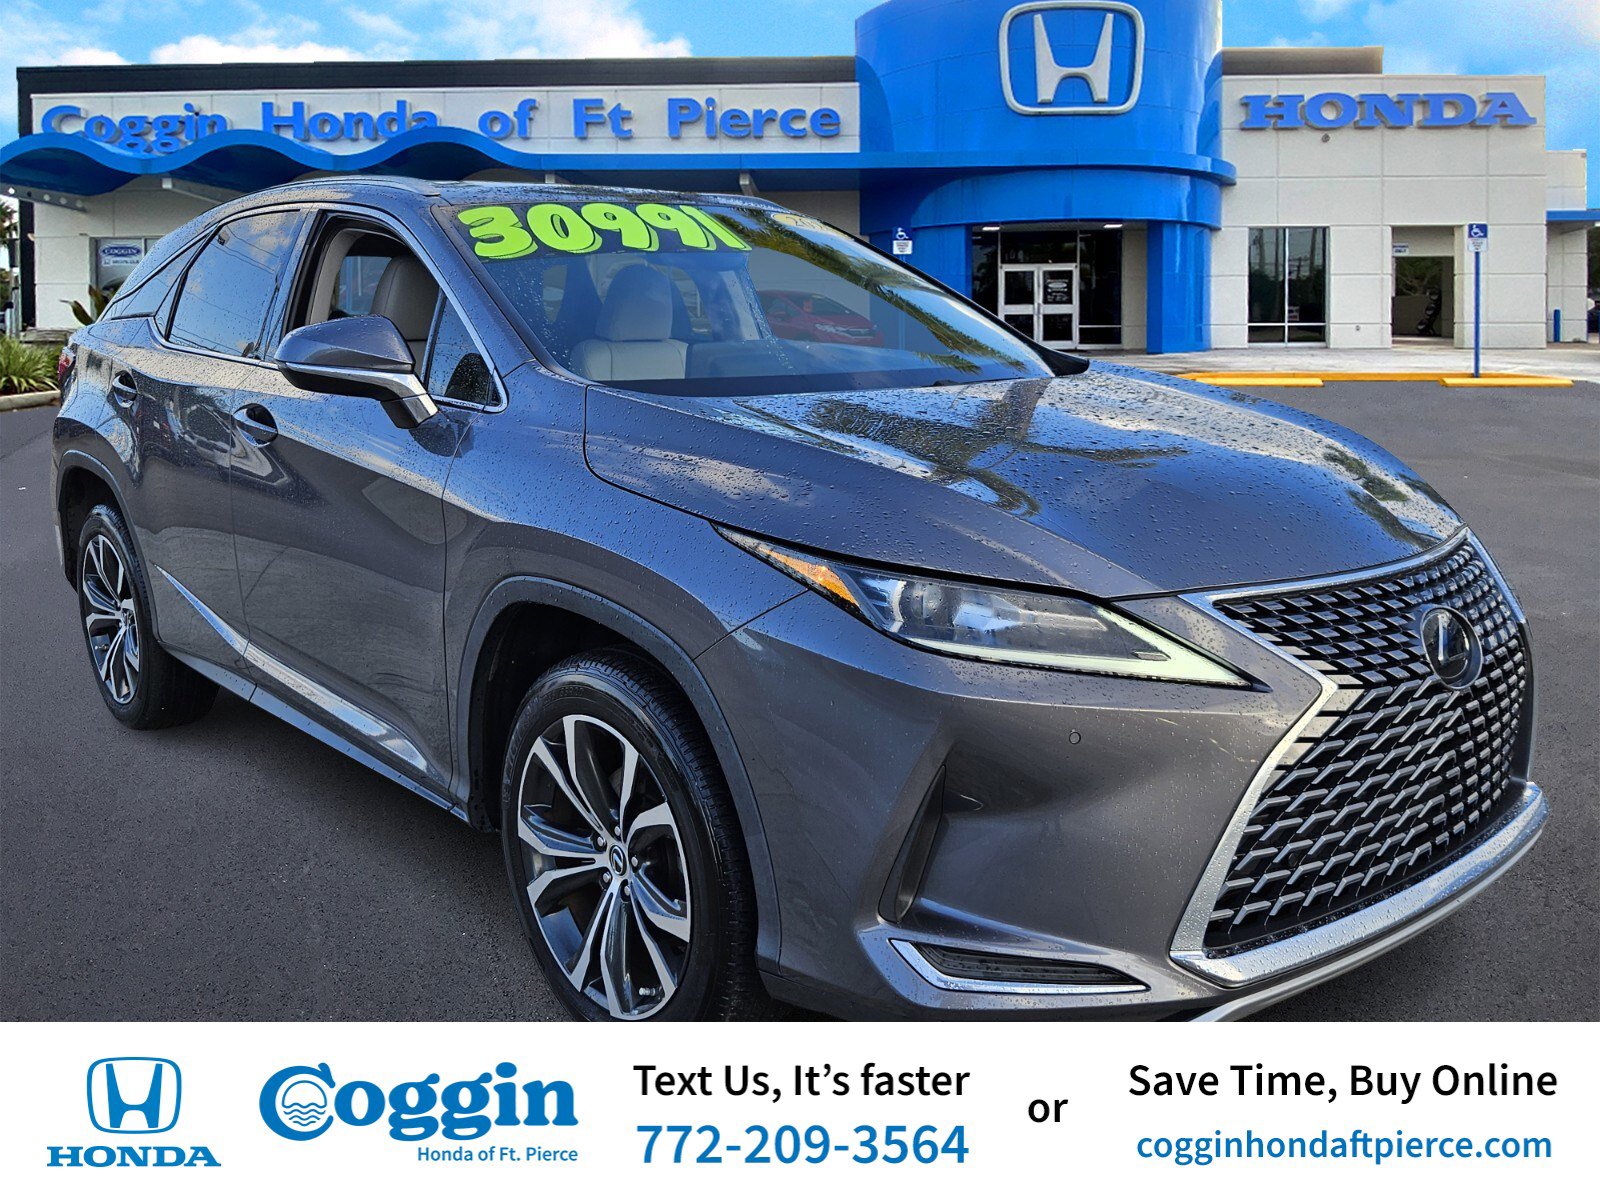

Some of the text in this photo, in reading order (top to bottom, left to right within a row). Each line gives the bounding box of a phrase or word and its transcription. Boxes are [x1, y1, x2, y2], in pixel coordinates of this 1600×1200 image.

[41, 97, 841, 155] Coggin Honda of Ft Pierce
[1239, 92, 1537, 130] HONDA
[457, 202, 752, 259] 30991
